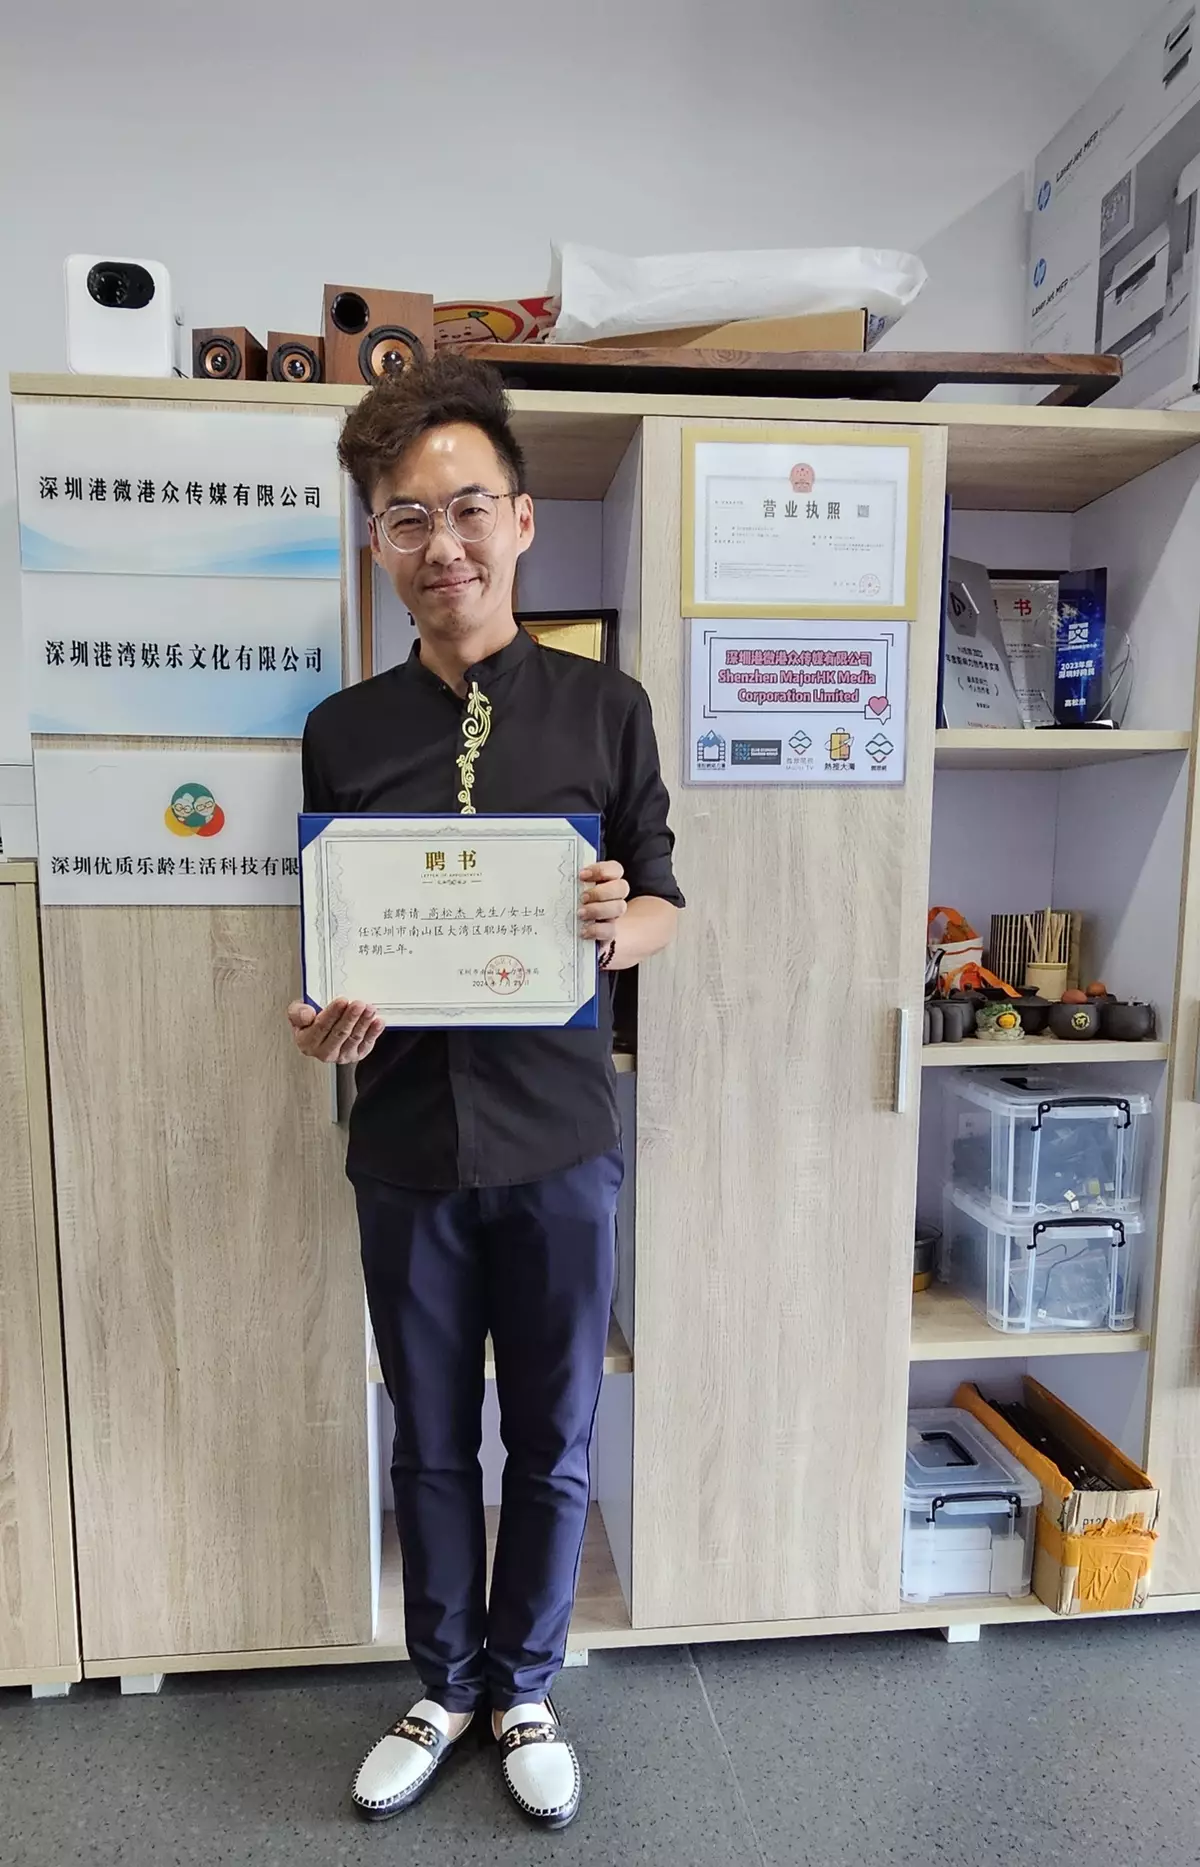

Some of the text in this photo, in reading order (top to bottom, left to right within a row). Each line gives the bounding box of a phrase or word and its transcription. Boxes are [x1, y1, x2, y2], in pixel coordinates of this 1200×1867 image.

[39, 475, 321, 509] 深圳港微港众传媒有限公司
[763, 499, 840, 520] 营业执照
[45, 639, 323, 674] 深圳港湾娱乐文化有限公司
[725, 650, 872, 667] 深圳港微港众传媒有限公司
[718, 669, 876, 687] Shenzhen MajorHK Media
[737, 688, 859, 706] Corporation Limited
[50, 855, 299, 876] 深圳优质乐龄生活科技有限
[425, 850, 477, 871] 聘书
